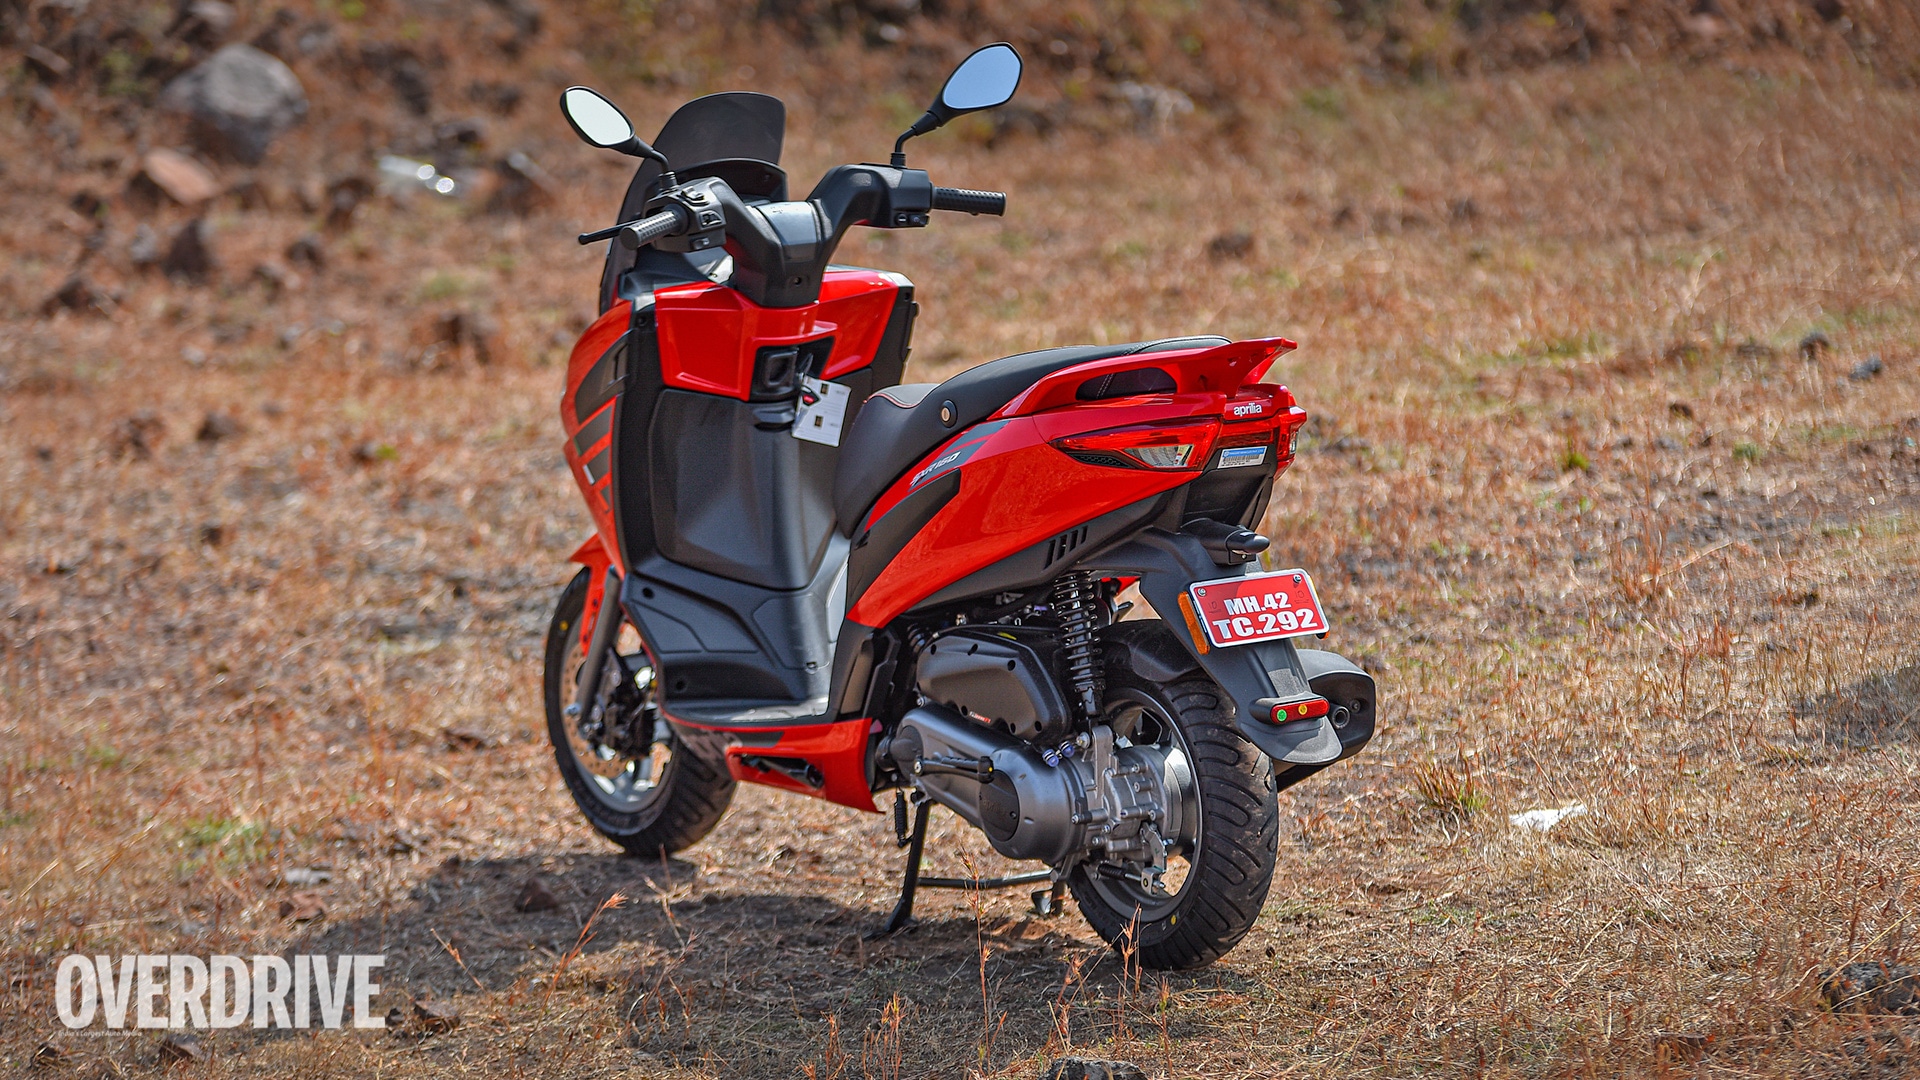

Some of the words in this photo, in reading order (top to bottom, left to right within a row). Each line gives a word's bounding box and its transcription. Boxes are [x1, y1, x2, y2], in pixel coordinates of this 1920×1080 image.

[1233, 402, 1263, 417] aprilia
[1223, 592, 1292, 616] MH.42
[1212, 608, 1318, 639] TC.292
